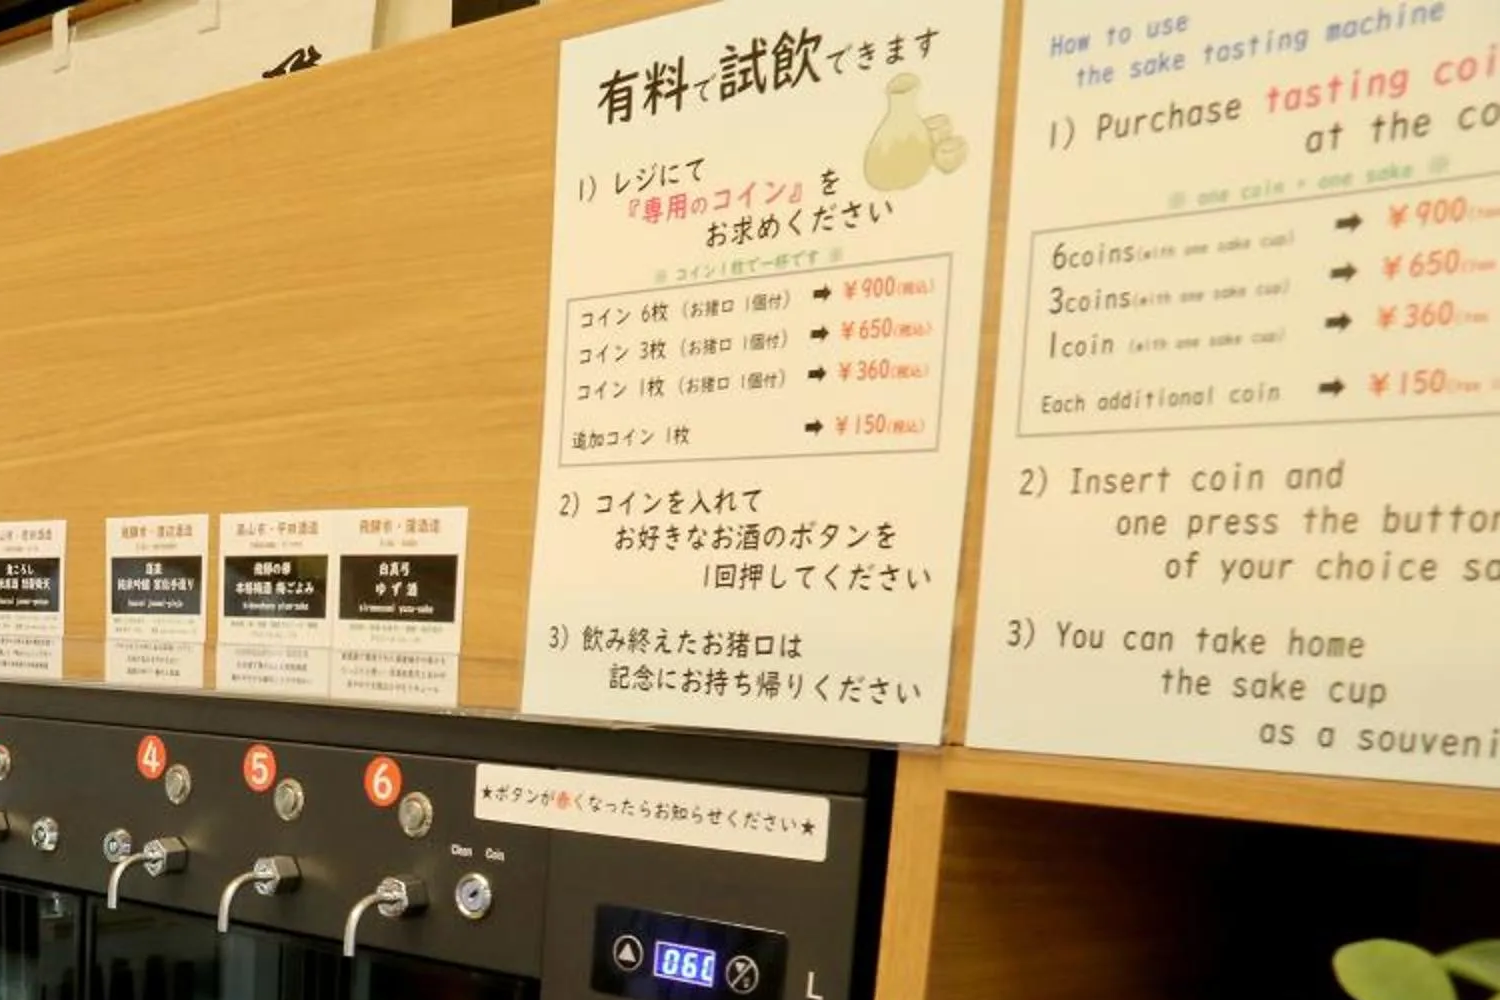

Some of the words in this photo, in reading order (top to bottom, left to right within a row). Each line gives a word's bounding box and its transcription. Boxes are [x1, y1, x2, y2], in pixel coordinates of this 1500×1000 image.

[1050, 35, 1091, 58] How
[1105, 26, 1132, 48] to
[1146, 14, 1190, 38] use
[1076, 65, 1115, 89] the
[1129, 52, 1187, 80] sake
[1203, 26, 1310, 67] tasting
[1324, 0, 1446, 44] machine
[597, 26, 940, 125] 有料で試飲できます
[1095, 96, 1242, 142] Purchase
[1265, 66, 1411, 115] tasting
[1304, 122, 1344, 156] at
[1371, 108, 1433, 147] the
[613, 157, 706, 195] レジにて
[706, 201, 895, 249] お求めください
[580, 306, 631, 329] コイン
[641, 302, 669, 324] 6枚
[579, 342, 629, 365] コイン
[639, 339, 667, 361] 3枚
[577, 381, 628, 401] コイン
[639, 375, 665, 399] 1枚
[1040, 394, 1086, 415] Each
[1097, 384, 1215, 412] additional
[1228, 382, 1282, 405] coin
[571, 427, 656, 450] 追加コイン
[1069, 465, 1172, 495] Insert
[1191, 462, 1265, 493] coin
[1285, 459, 1347, 490] and
[595, 487, 764, 515] コインを入れて
[613, 520, 898, 552] お好きなお酒のボタンを
[1115, 512, 1168, 537] one
[1187, 510, 1280, 541] press
[1301, 504, 1360, 535] the
[703, 562, 932, 592] 1回押してください
[1163, 550, 1201, 580] of
[1219, 554, 1295, 586] your
[1314, 550, 1439, 582] choice
[581, 622, 804, 660] 飲み終えたお猪口は
[1055, 620, 1106, 651] You
[1121, 624, 1175, 653] can
[1195, 626, 1267, 657] take
[1287, 628, 1367, 660] home
[607, 663, 923, 706] 記念にお持ち帰りください
[1160, 668, 1213, 698] the
[1231, 672, 1308, 702] sake
[1327, 677, 1389, 710] cup
[1258, 722, 1296, 747] as
[1316, 726, 1336, 748] a
[805, 971, 824, 1000] L
